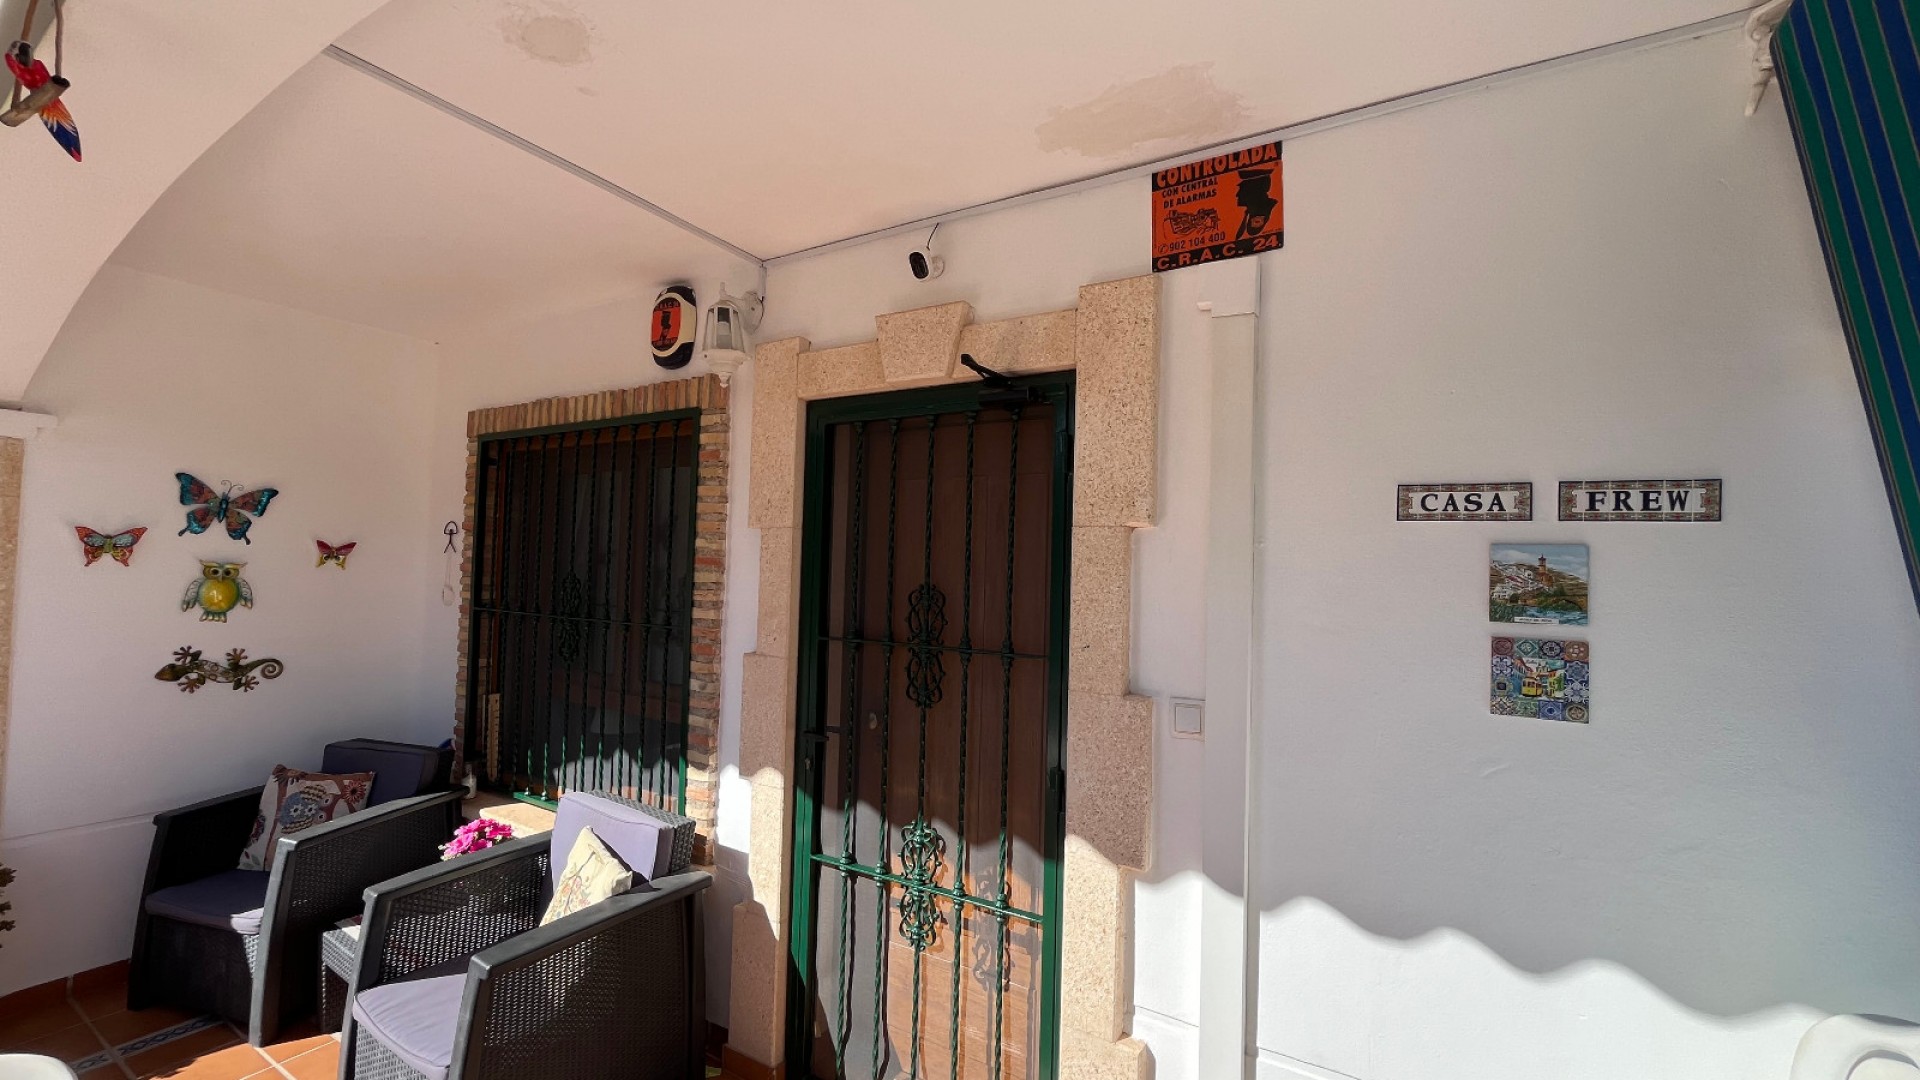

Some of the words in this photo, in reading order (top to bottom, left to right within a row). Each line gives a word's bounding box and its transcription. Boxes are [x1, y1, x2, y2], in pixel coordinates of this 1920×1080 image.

[1156, 143, 1277, 187] CONTROLADA
[1162, 188, 1179, 198] CON
[1181, 177, 1219, 193] CENTRAL
[1163, 200, 1174, 209] DE
[1176, 188, 1217, 205] ALARMAS
[1169, 240, 1186, 252] 902
[1420, 492, 1507, 512] CASA
[1585, 490, 1690, 512] FREW
